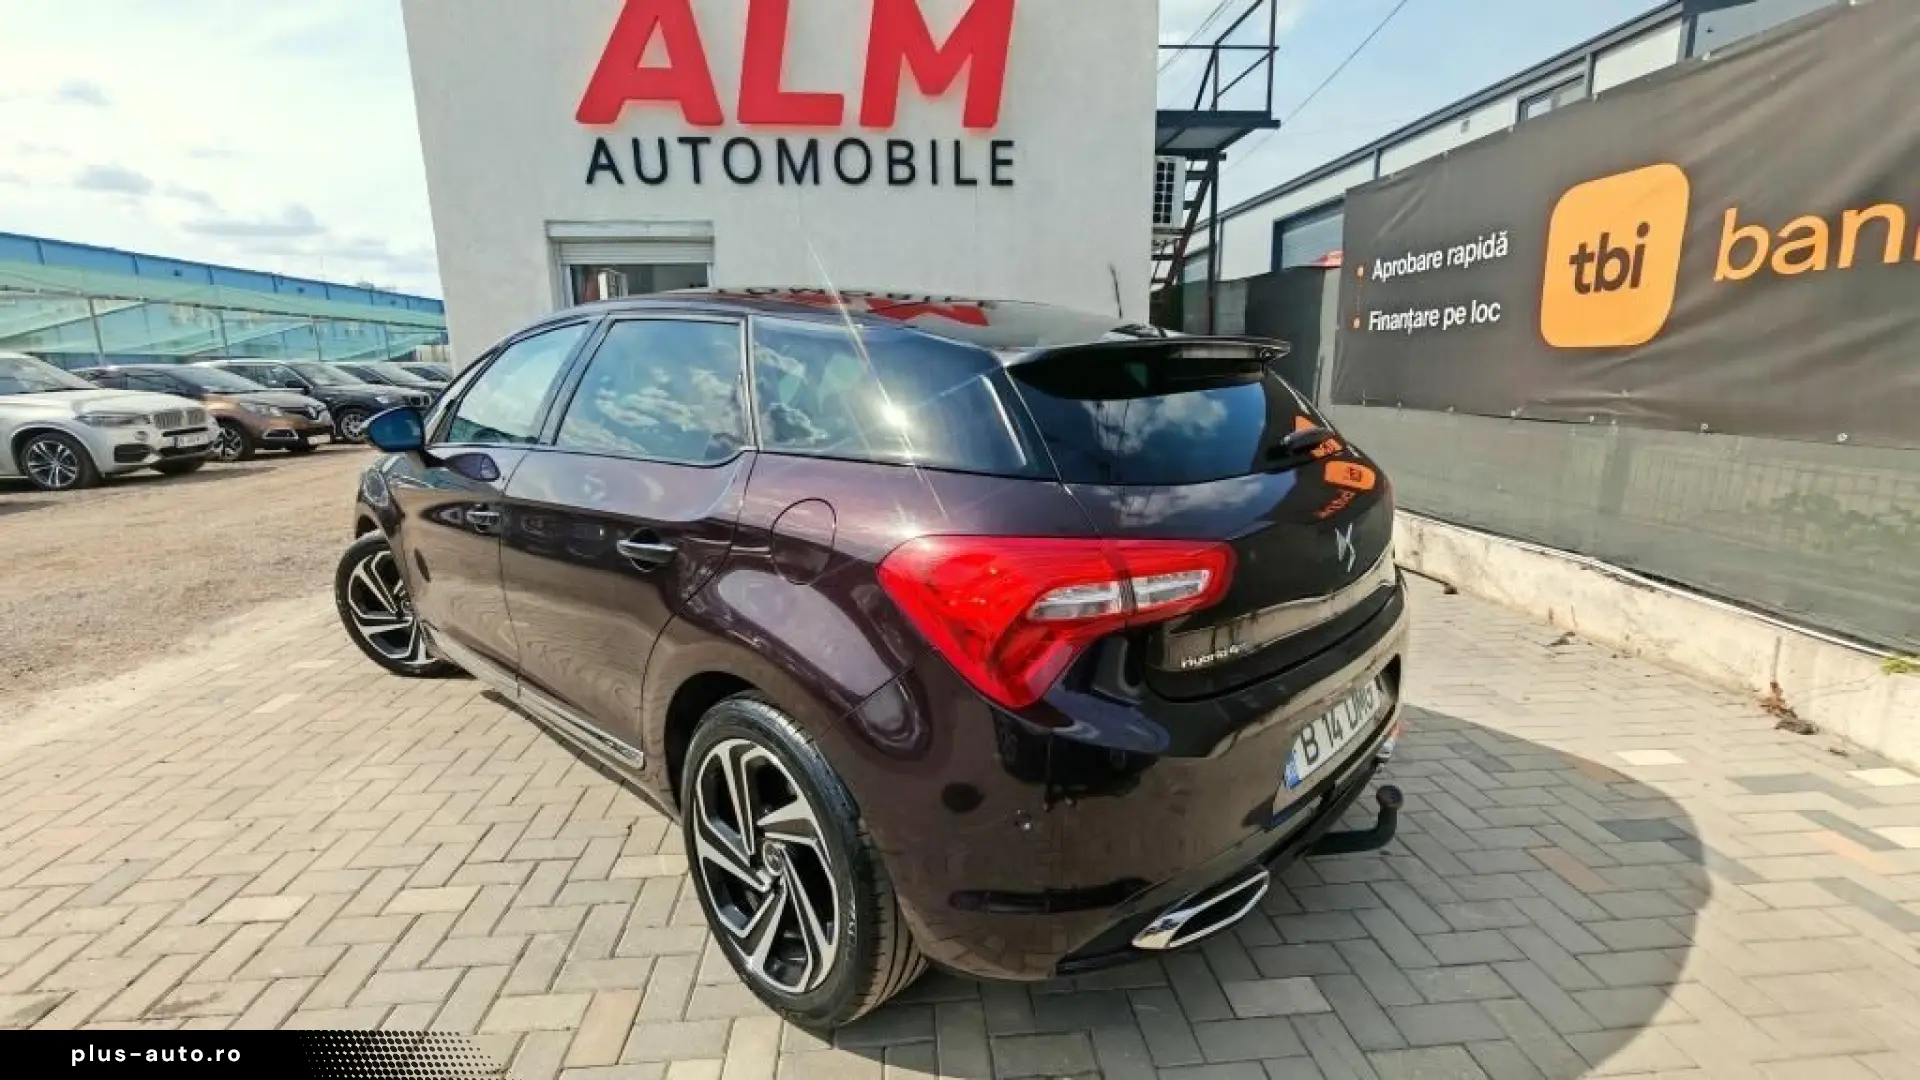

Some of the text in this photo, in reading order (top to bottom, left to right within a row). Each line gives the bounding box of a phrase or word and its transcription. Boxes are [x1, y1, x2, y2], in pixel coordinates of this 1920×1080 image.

[575, 0, 1016, 129] ALM
[585, 136, 1015, 187] AUTOMOBILE
[1371, 229, 1509, 283] Aprobare rapidă
[1568, 202, 1920, 295] tbi ban
[1441, 304, 1467, 331] pe
[1469, 299, 1501, 324] loc
[1299, 721, 1319, 766] B
[1321, 708, 1344, 749] 14
